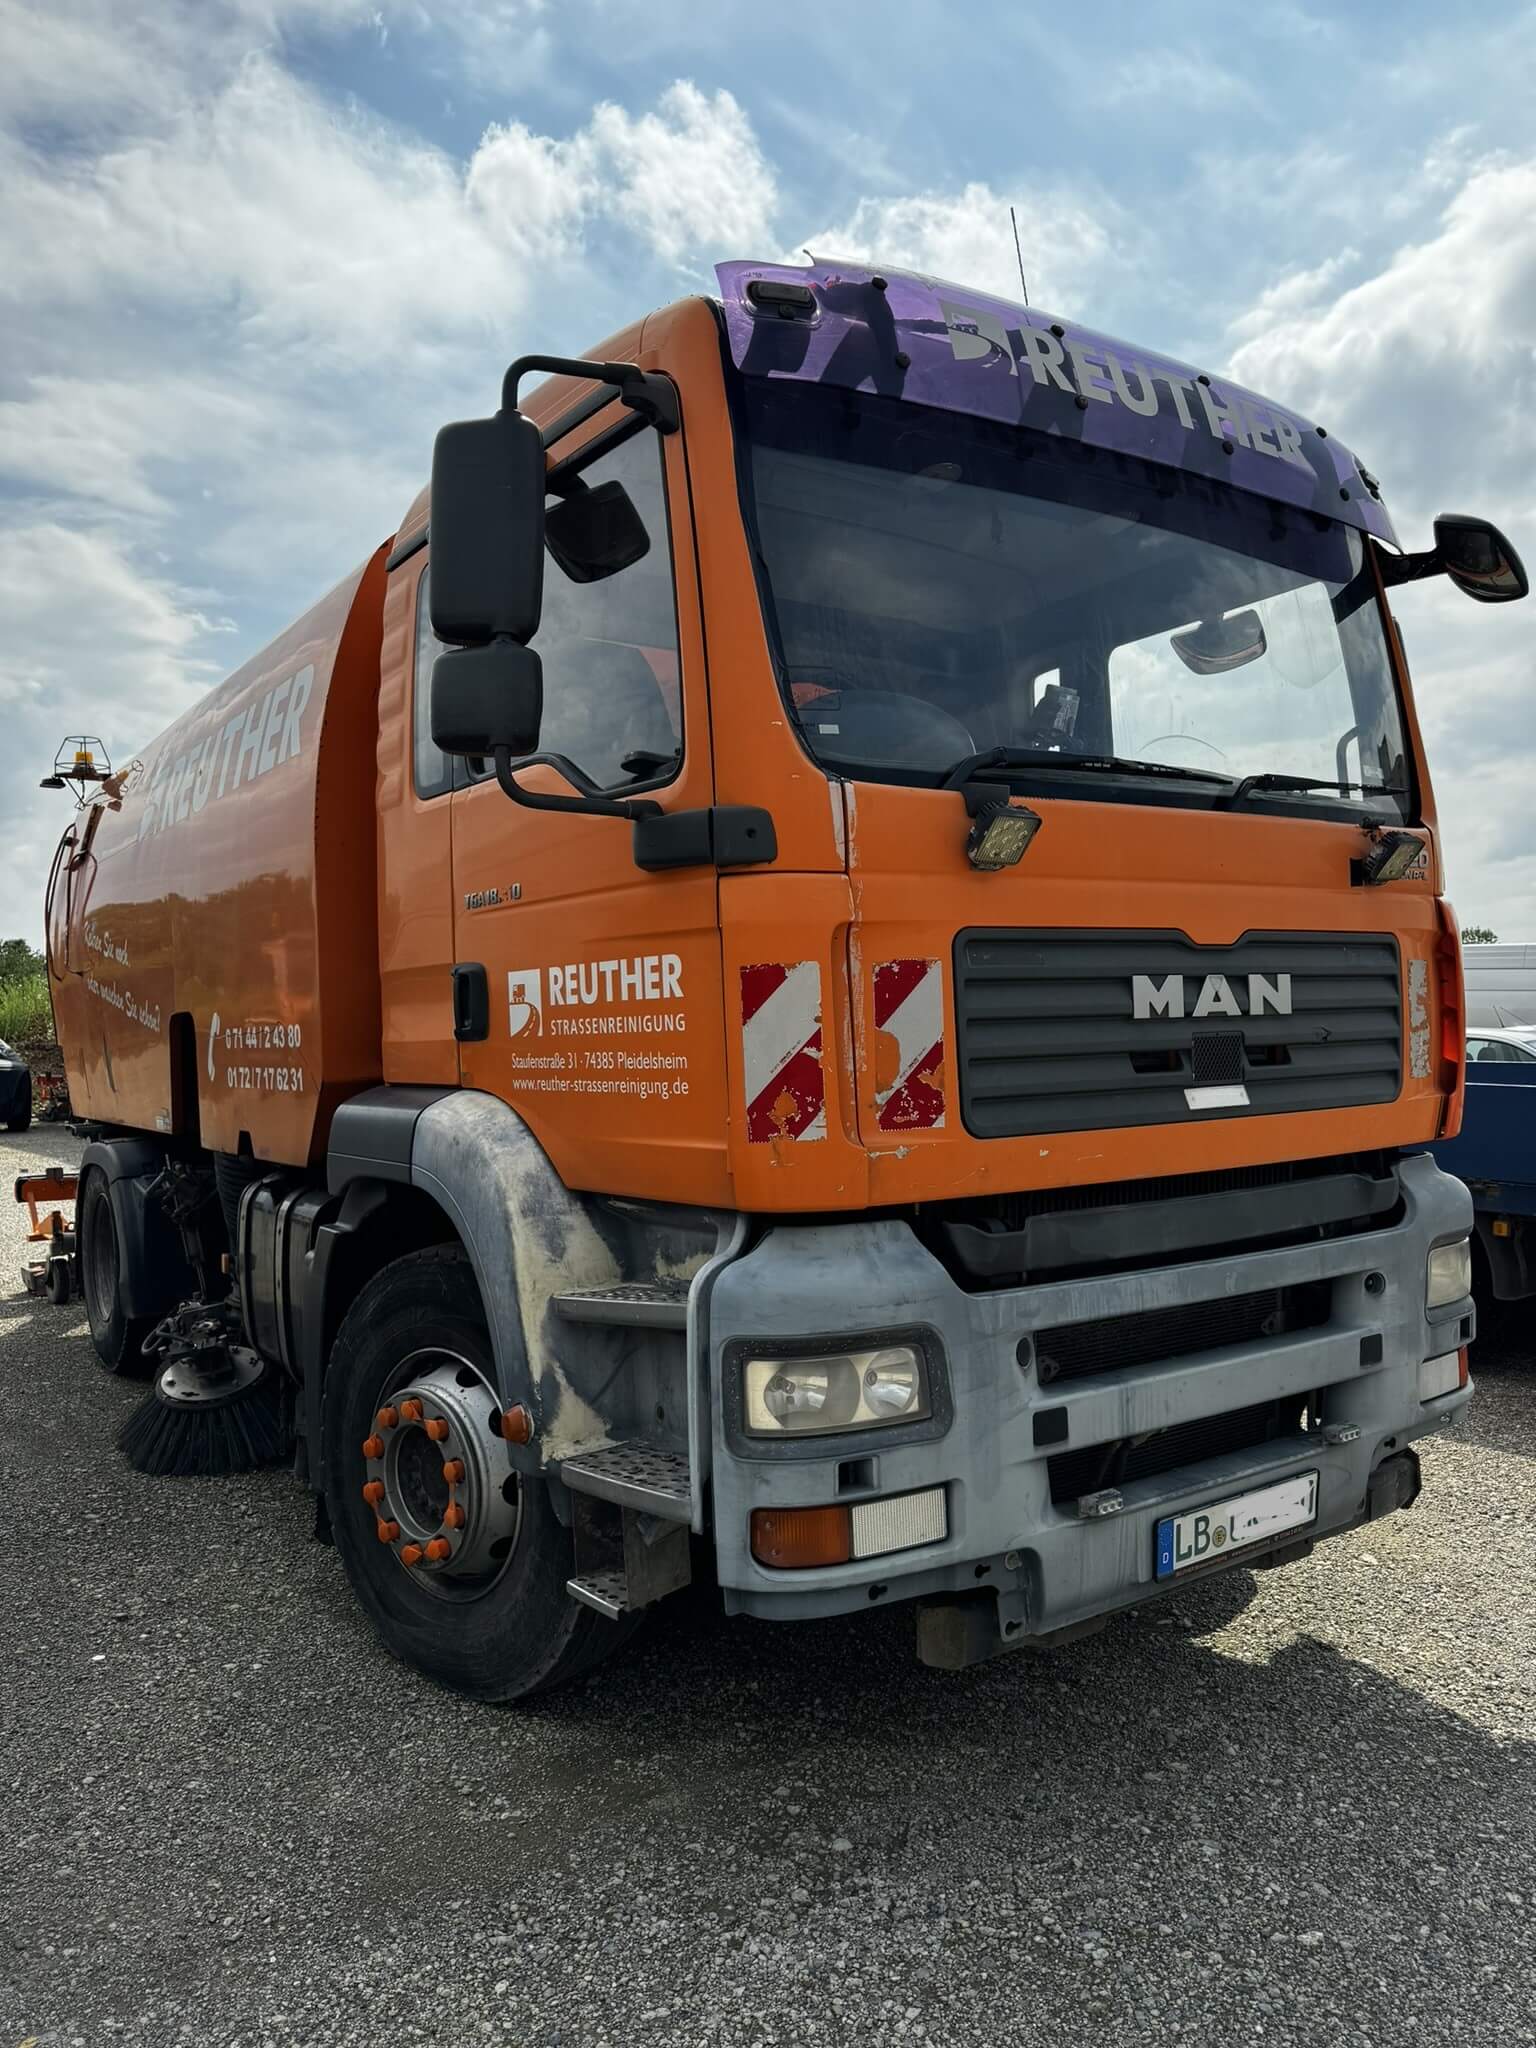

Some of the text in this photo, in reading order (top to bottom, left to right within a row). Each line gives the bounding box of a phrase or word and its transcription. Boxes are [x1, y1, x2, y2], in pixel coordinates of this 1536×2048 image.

[1021, 325, 1302, 459] REUTHER
[161, 663, 315, 832] REUTHER
[549, 954, 684, 1006] REUTHER
[1132, 974, 1292, 1019] MAN
[287, 1024, 301, 1048] 80
[551, 1013, 686, 1036] STRASSENREINIGUNG
[511, 1052, 566, 1070] Staufenstraße
[567, 1053, 577, 1069] 31
[584, 1051, 615, 1069] 74385
[617, 1051, 688, 1070] Pleidelsheim
[512, 1076, 689, 1100] www.reuther-strassenreinigung.de
[1175, 1515, 1211, 1563] LB
[1162, 1552, 1169, 1564] D
